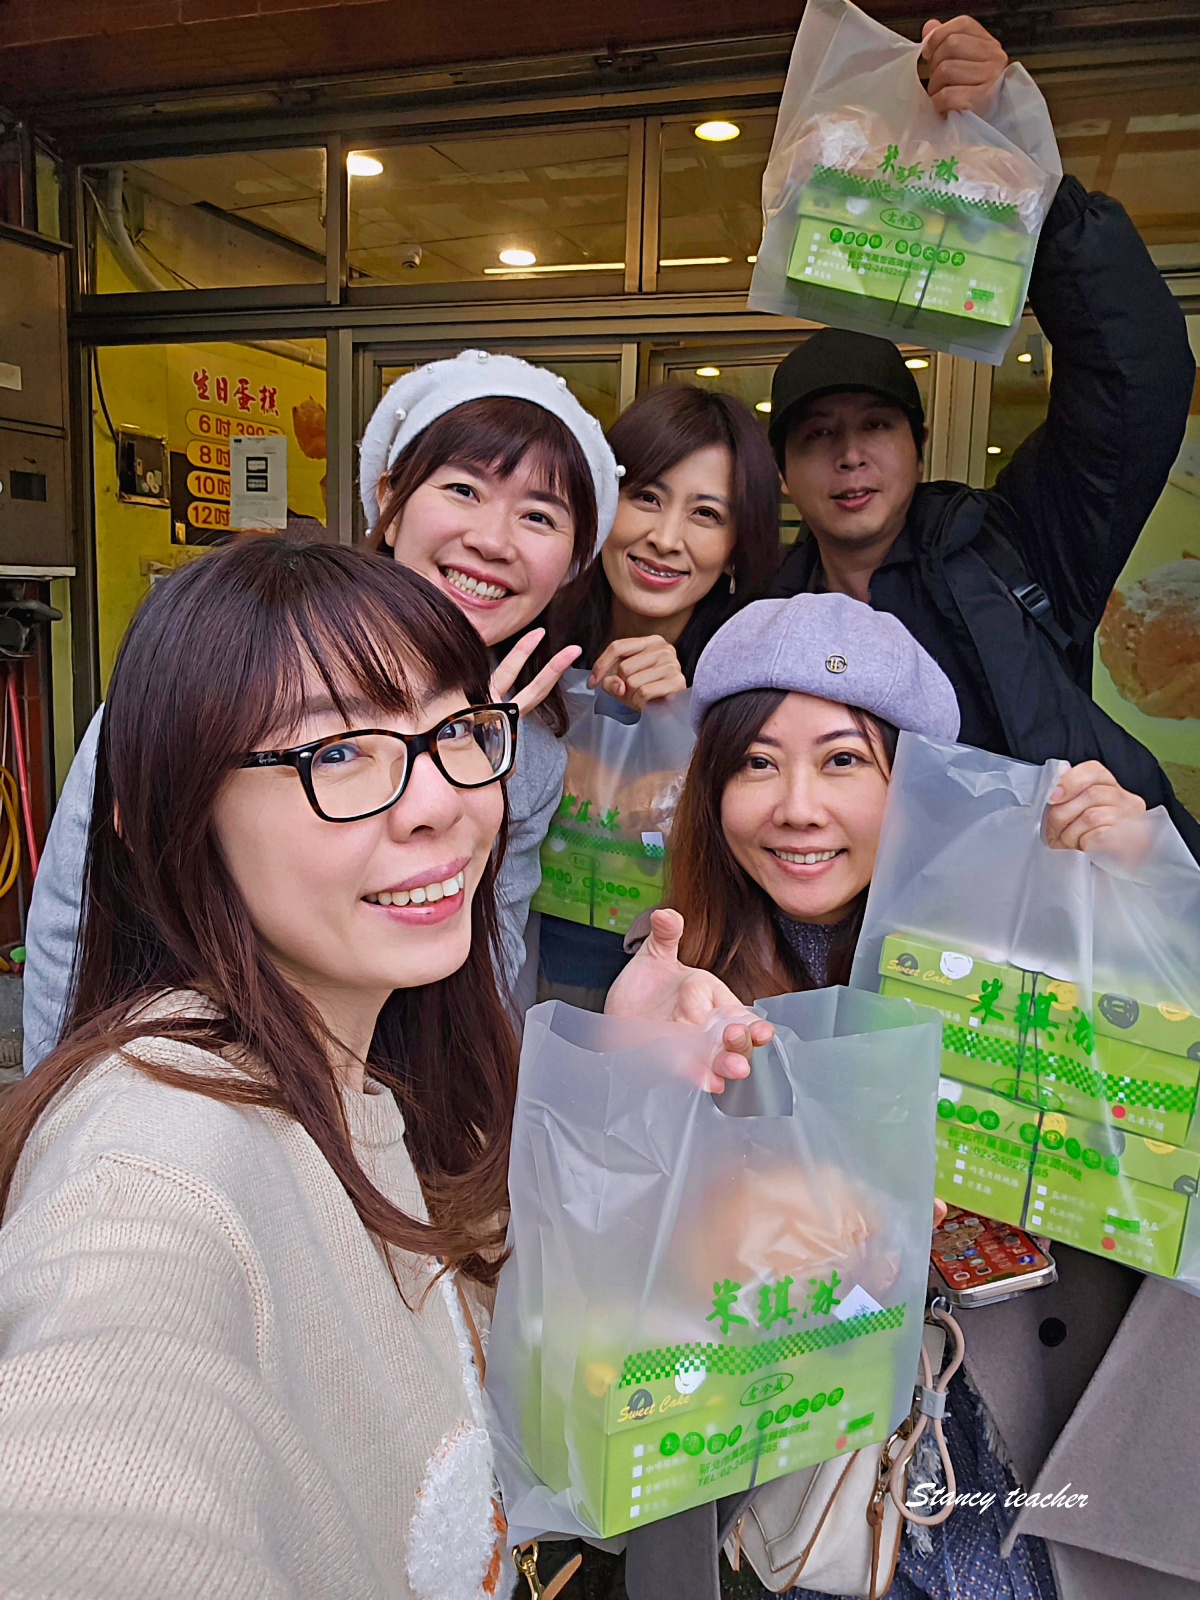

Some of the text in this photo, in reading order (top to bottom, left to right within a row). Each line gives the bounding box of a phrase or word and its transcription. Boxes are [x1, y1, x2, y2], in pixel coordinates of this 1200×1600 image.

[193, 368, 279, 417] 生日蛋糕
[199, 415, 231, 438] 6吋
[200, 445, 230, 468] 8吋
[194, 475, 230, 498] 10吋
[193, 505, 230, 527] 12吋
[887, 959, 953, 986] Sweet Cake
[617, 1395, 690, 1423] Sweet Cake
